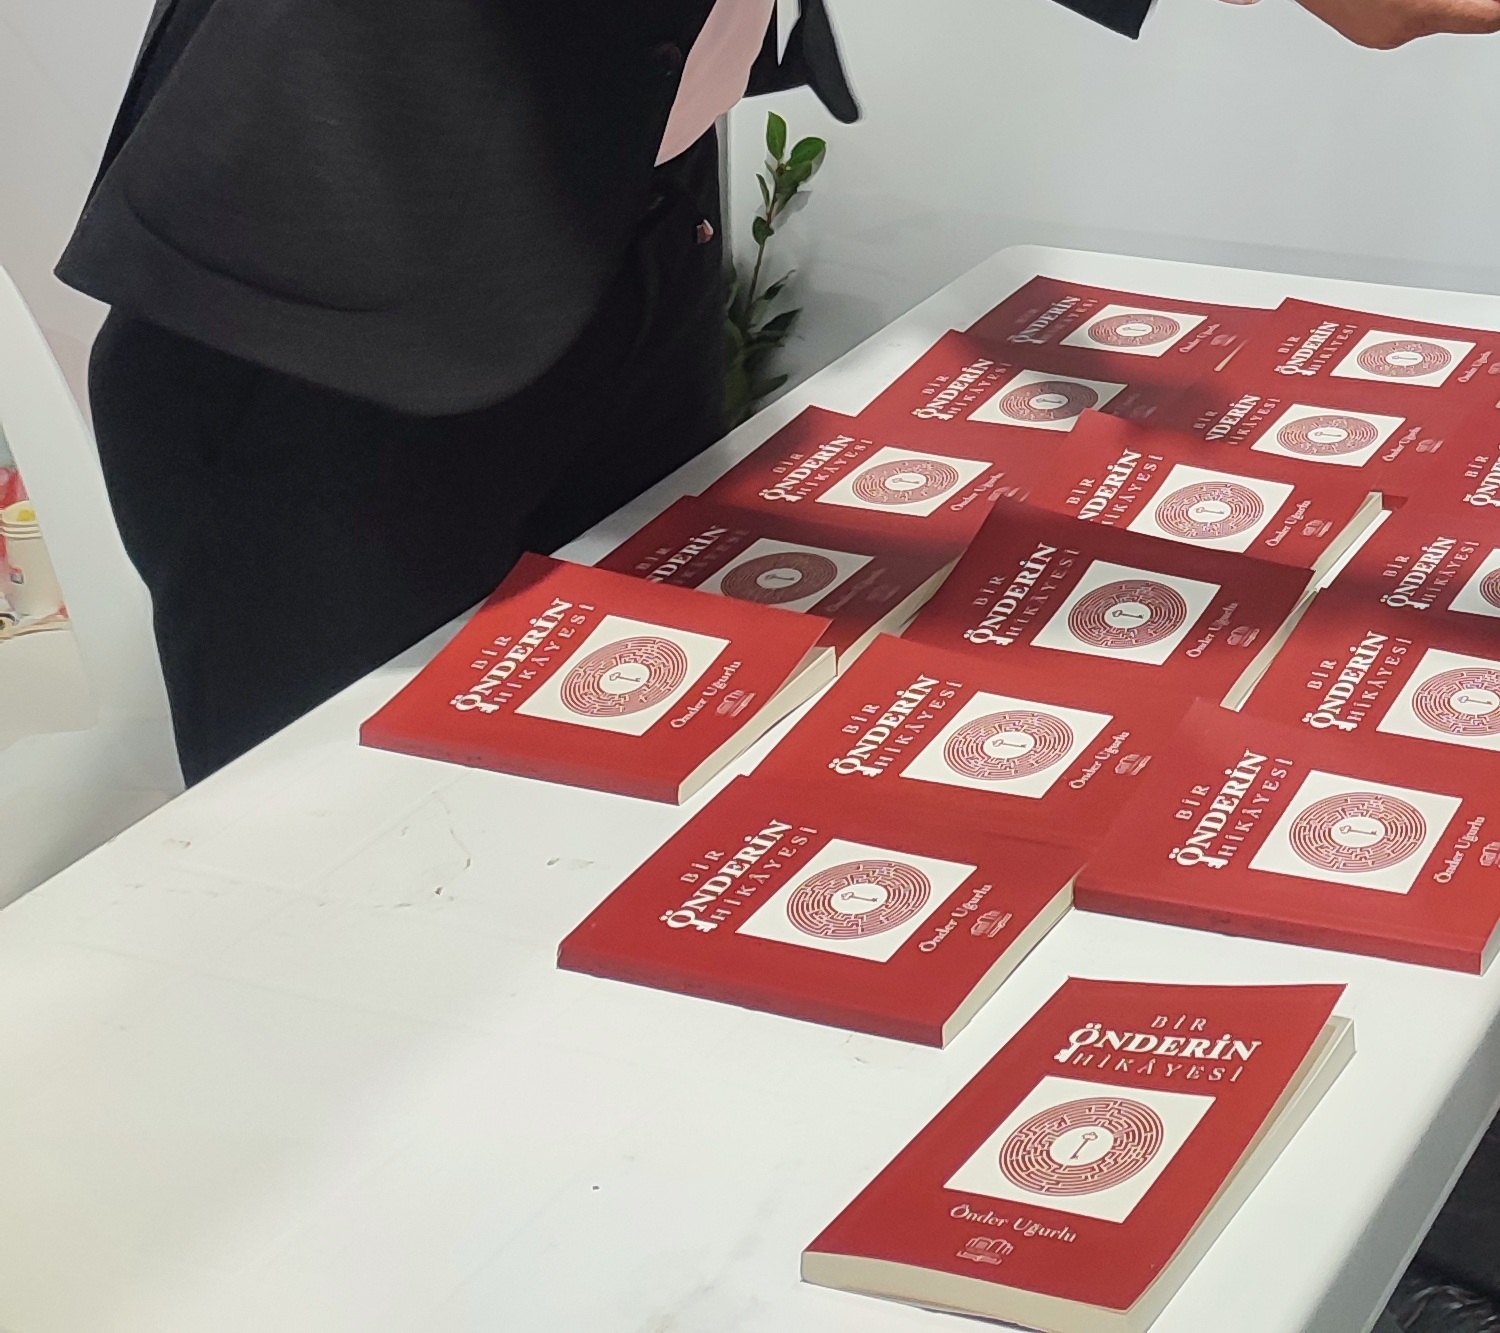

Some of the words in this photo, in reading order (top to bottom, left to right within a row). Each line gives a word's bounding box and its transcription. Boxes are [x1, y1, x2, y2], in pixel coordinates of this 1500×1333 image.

[758, 434, 856, 503] ÖNDERİN
[963, 542, 1059, 647] ÖNDERİN
[1380, 535, 1458, 610] ÖNDERİN
[450, 597, 573, 714] ÖNDERİN
[1301, 631, 1388, 732] ÖNDERİN
[826, 673, 940, 777] ÖNDERİN
[1168, 748, 1268, 870] ÖNDERİN
[658, 818, 794, 933] ÖNDERİN
[1053, 1023, 1262, 1063] ÖNDERİN
[1150, 1014, 1208, 1031] BİR
[949, 1203, 1010, 1228] Önder
